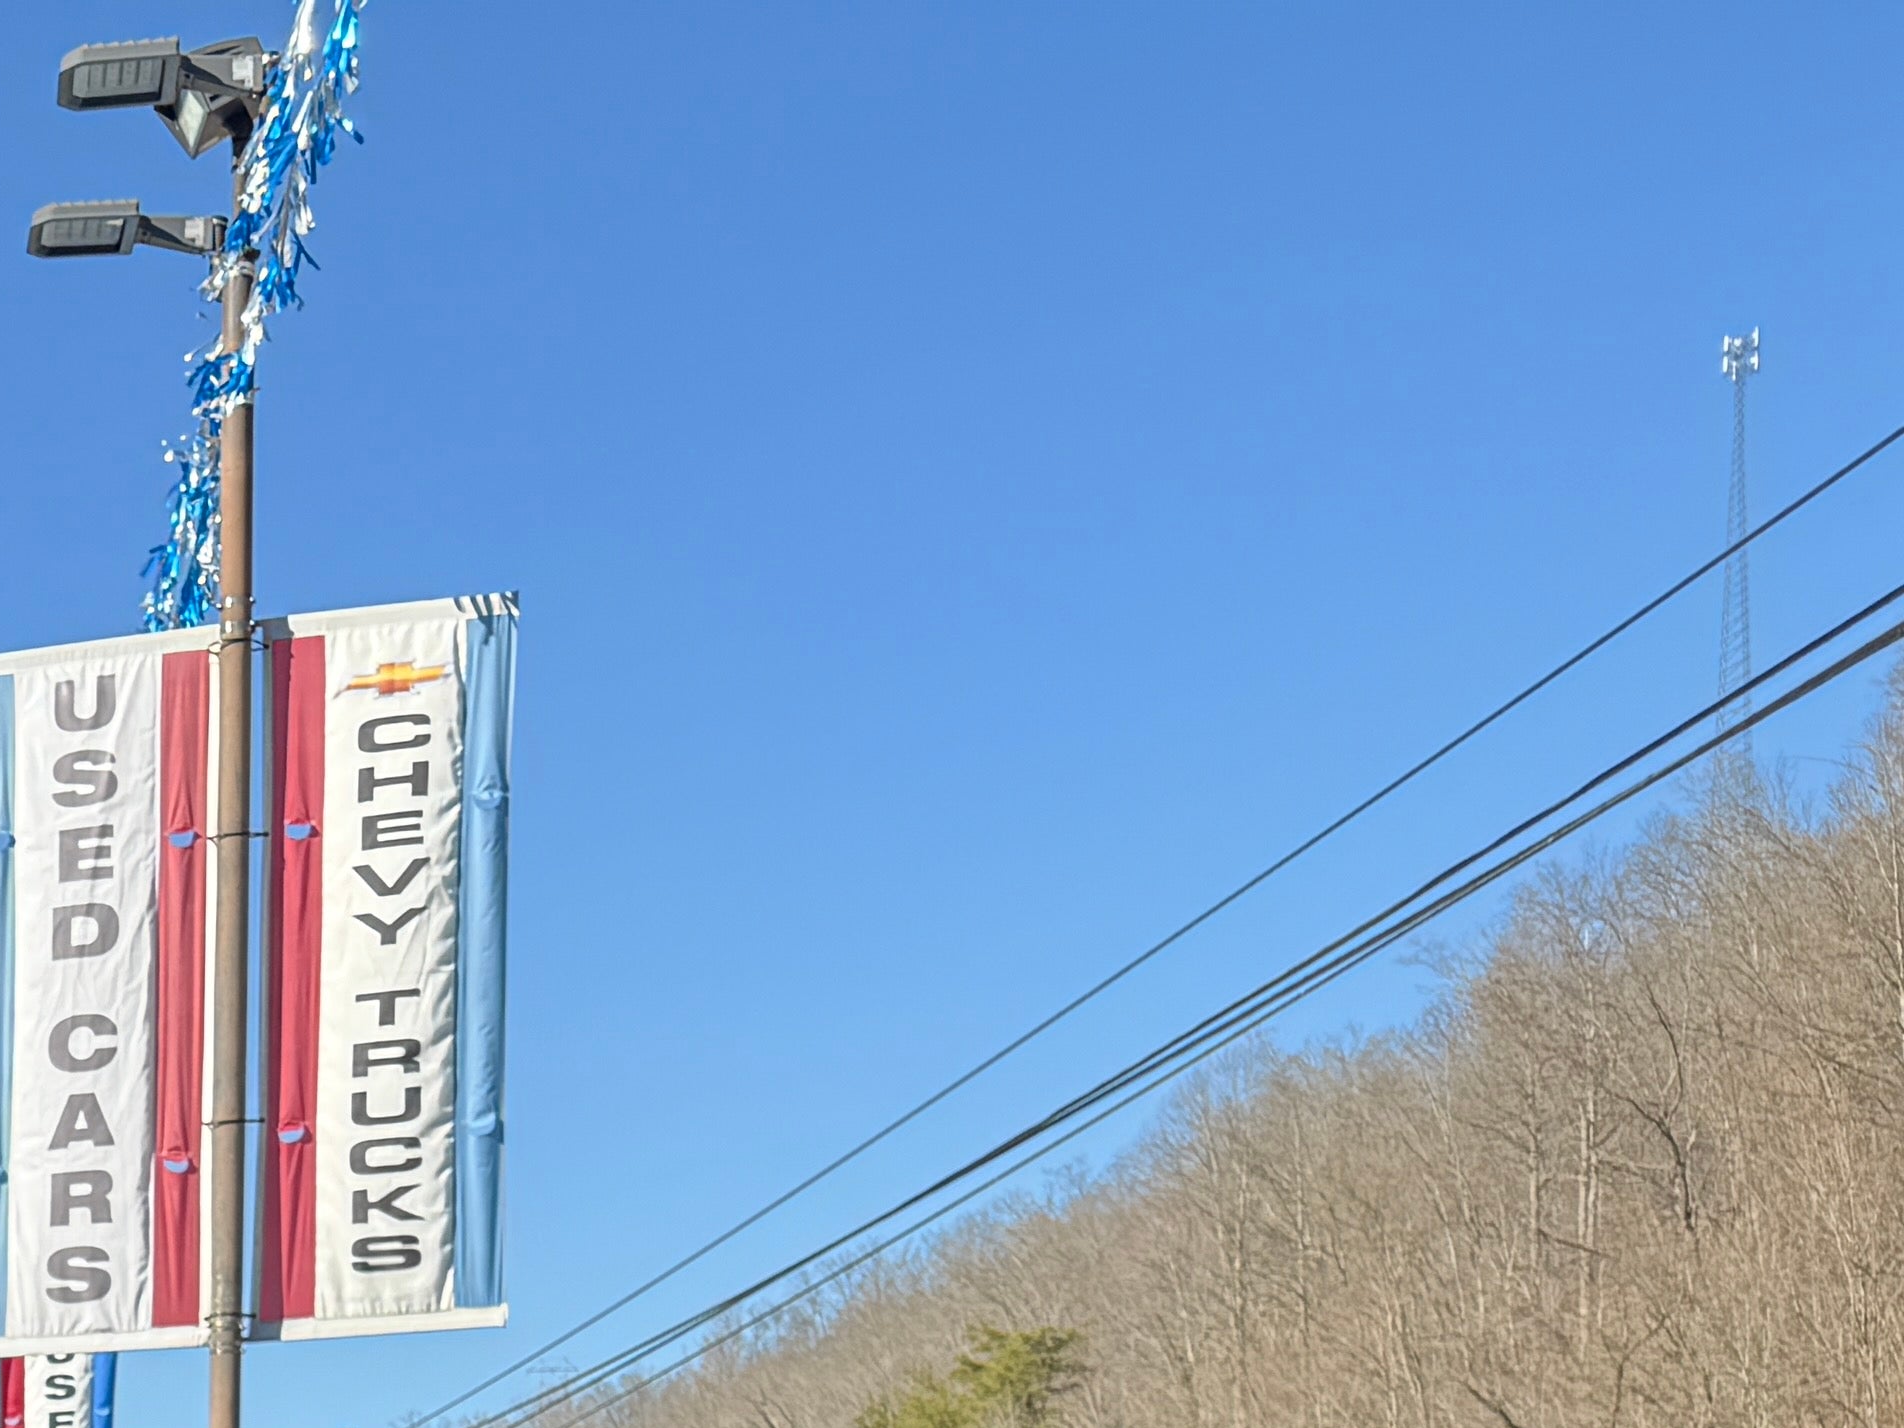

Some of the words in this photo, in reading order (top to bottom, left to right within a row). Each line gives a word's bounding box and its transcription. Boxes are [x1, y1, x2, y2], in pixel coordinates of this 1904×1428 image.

[51, 672, 120, 962] USED
[352, 712, 432, 946] CHEVY
[45, 1012, 119, 1305] CARS
[349, 988, 424, 1274] TRUCKS
